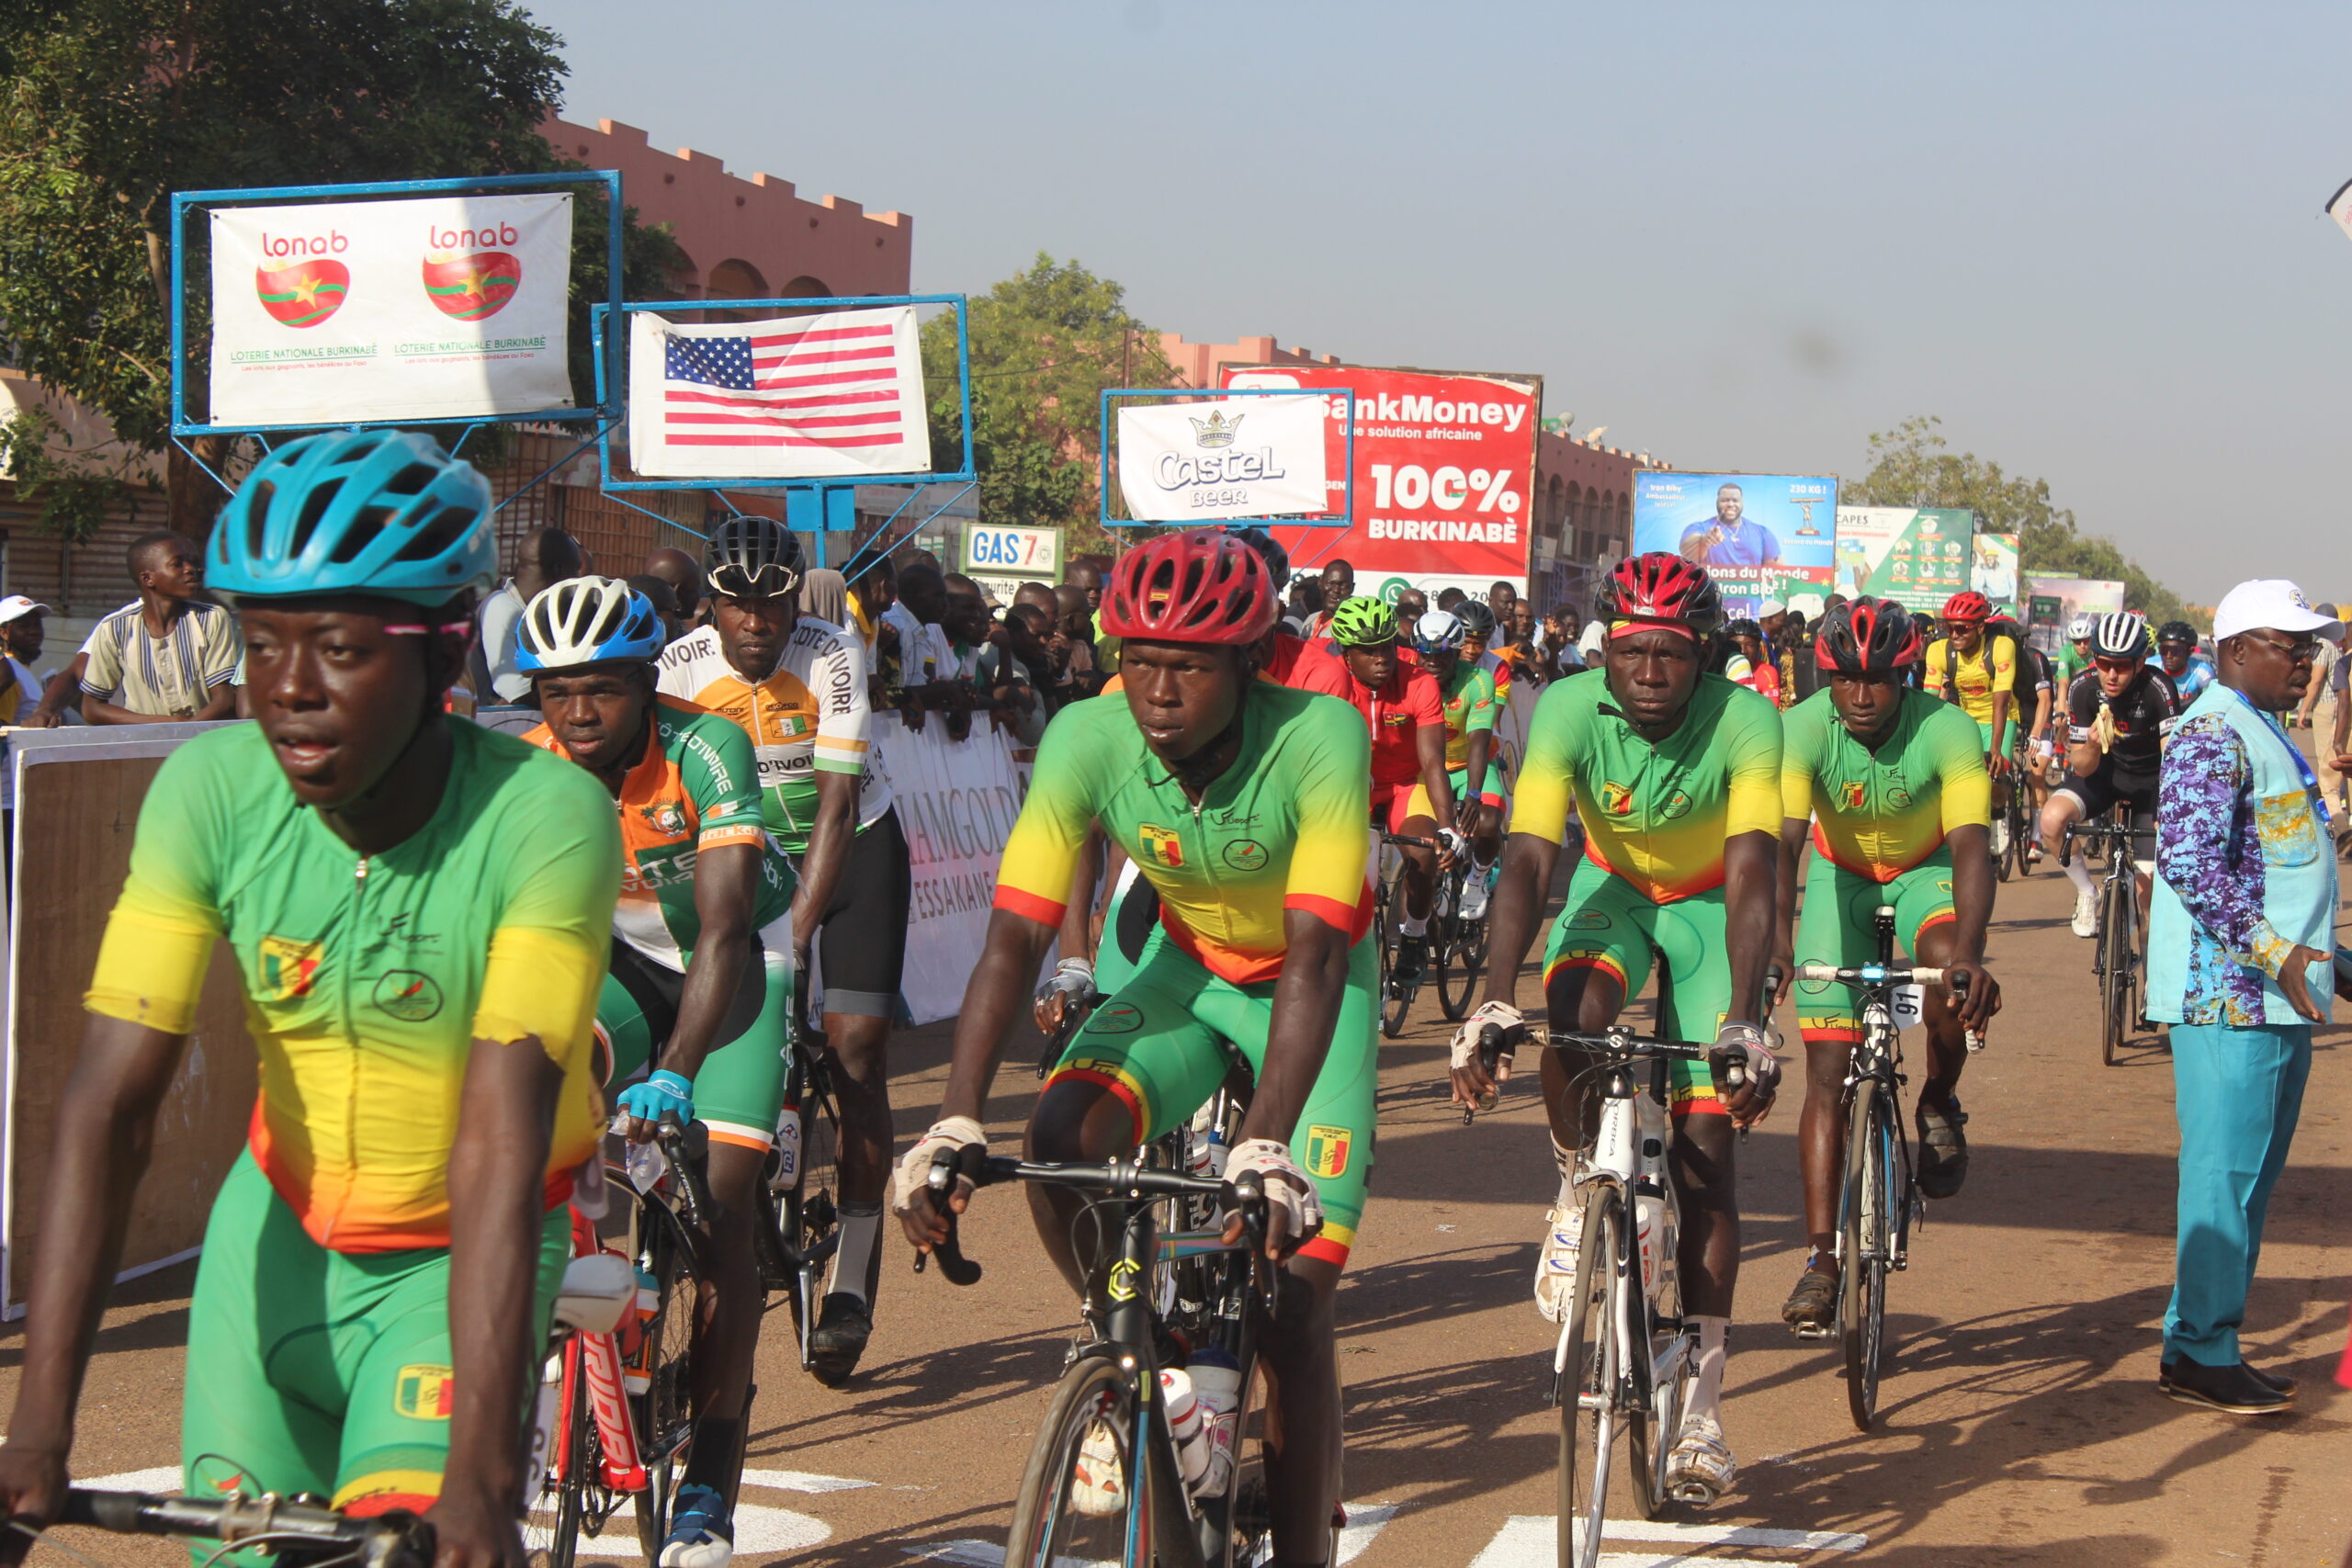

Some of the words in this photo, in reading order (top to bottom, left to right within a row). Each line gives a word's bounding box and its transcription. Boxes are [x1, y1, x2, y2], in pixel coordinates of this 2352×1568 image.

[263, 230, 348, 257] lonab
[431, 221, 518, 249] lonab
[231, 350, 270, 360] LOTERIE
[274, 347, 323, 358] NATIONALE
[394, 343, 435, 354] LOTERIE
[439, 340, 492, 351] NATIONALE
[1339, 423, 1365, 437] Ue
[1367, 423, 1421, 440] solution
[1425, 426, 1482, 441] africaine
[1371, 464, 1521, 513] 100%
[1790, 484, 1806, 493] 230
[1808, 484, 1821, 494] KG
[973, 532, 1020, 564] GAS
[1023, 535, 1037, 565] 7
[1739, 567, 1758, 579] du
[1895, 992, 1918, 1015] 91
[1609, 1103, 1619, 1156] ORBEA
[583, 1329, 633, 1465] RIDA
